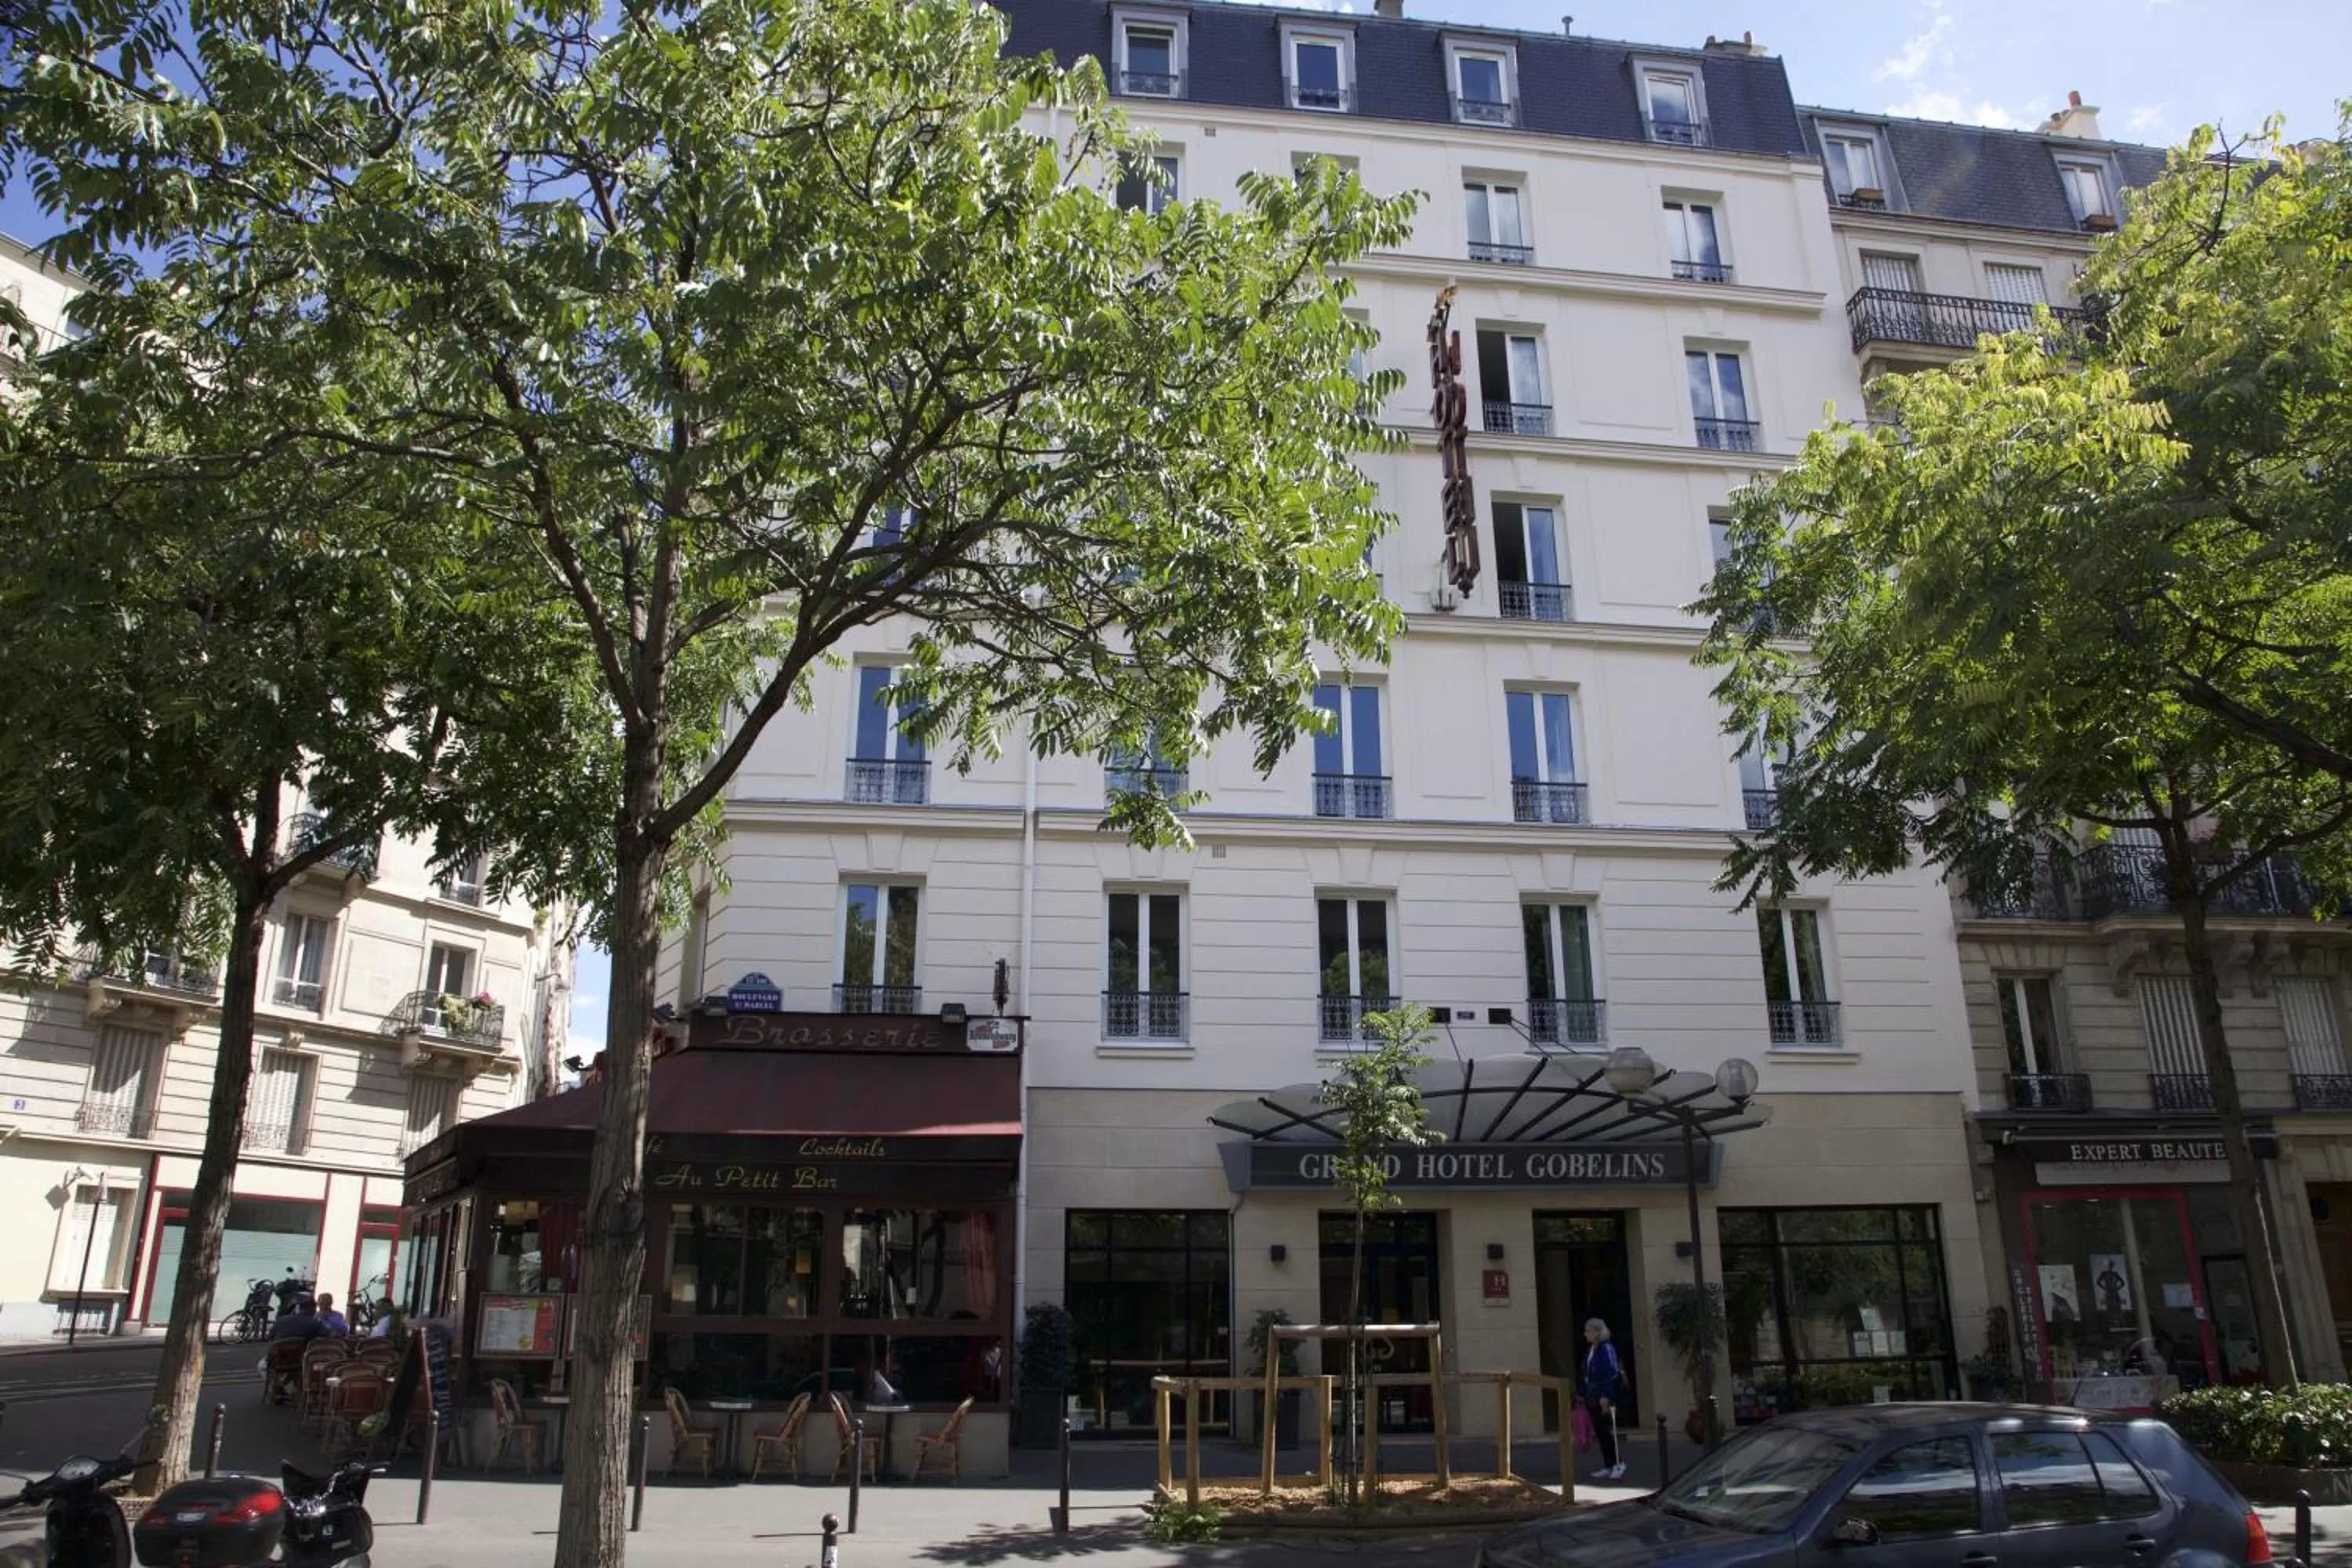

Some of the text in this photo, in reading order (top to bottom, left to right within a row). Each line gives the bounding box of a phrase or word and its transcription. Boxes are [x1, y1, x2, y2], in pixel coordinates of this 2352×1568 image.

[715, 1015, 942, 1048] Brasserie
[799, 1138, 887, 1157] Cocktails
[2070, 1142, 2226, 1160] EXPERT BEAUTE
[653, 1164, 838, 1190] Au Petit Bar
[1299, 1152, 1665, 1179] GRND HOTEL GOBELINS
